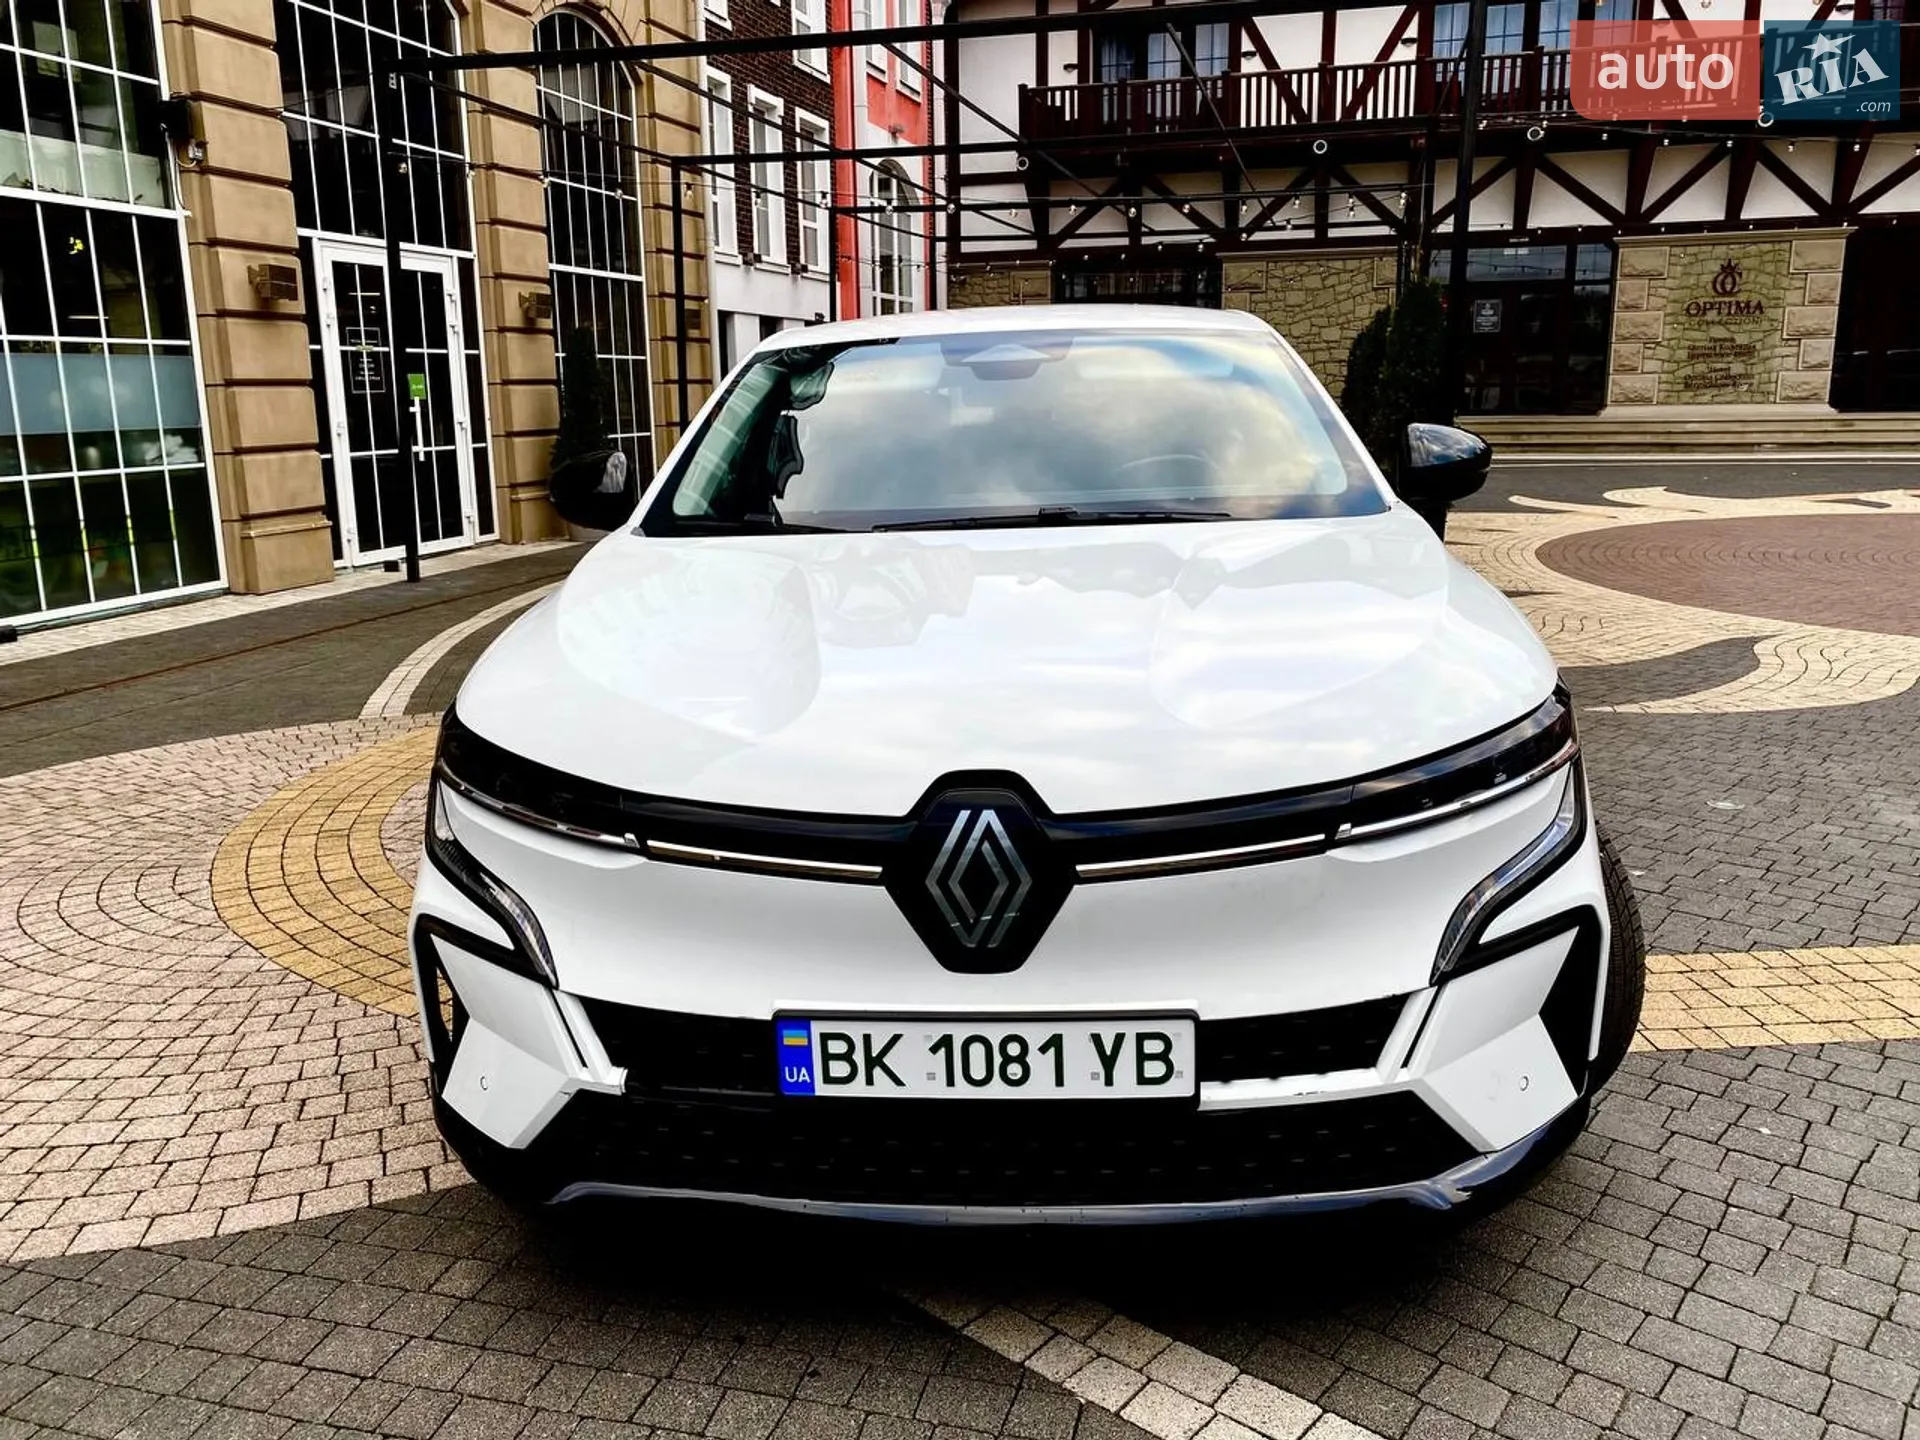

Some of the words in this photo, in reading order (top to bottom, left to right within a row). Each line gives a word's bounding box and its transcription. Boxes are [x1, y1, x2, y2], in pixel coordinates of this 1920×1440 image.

[1686, 300, 1764, 317] OPTIMA
[819, 1031, 906, 1087] BK
[928, 1033, 1065, 1088] 1081
[1091, 1031, 1176, 1087] YB
[784, 1066, 811, 1083] UA
